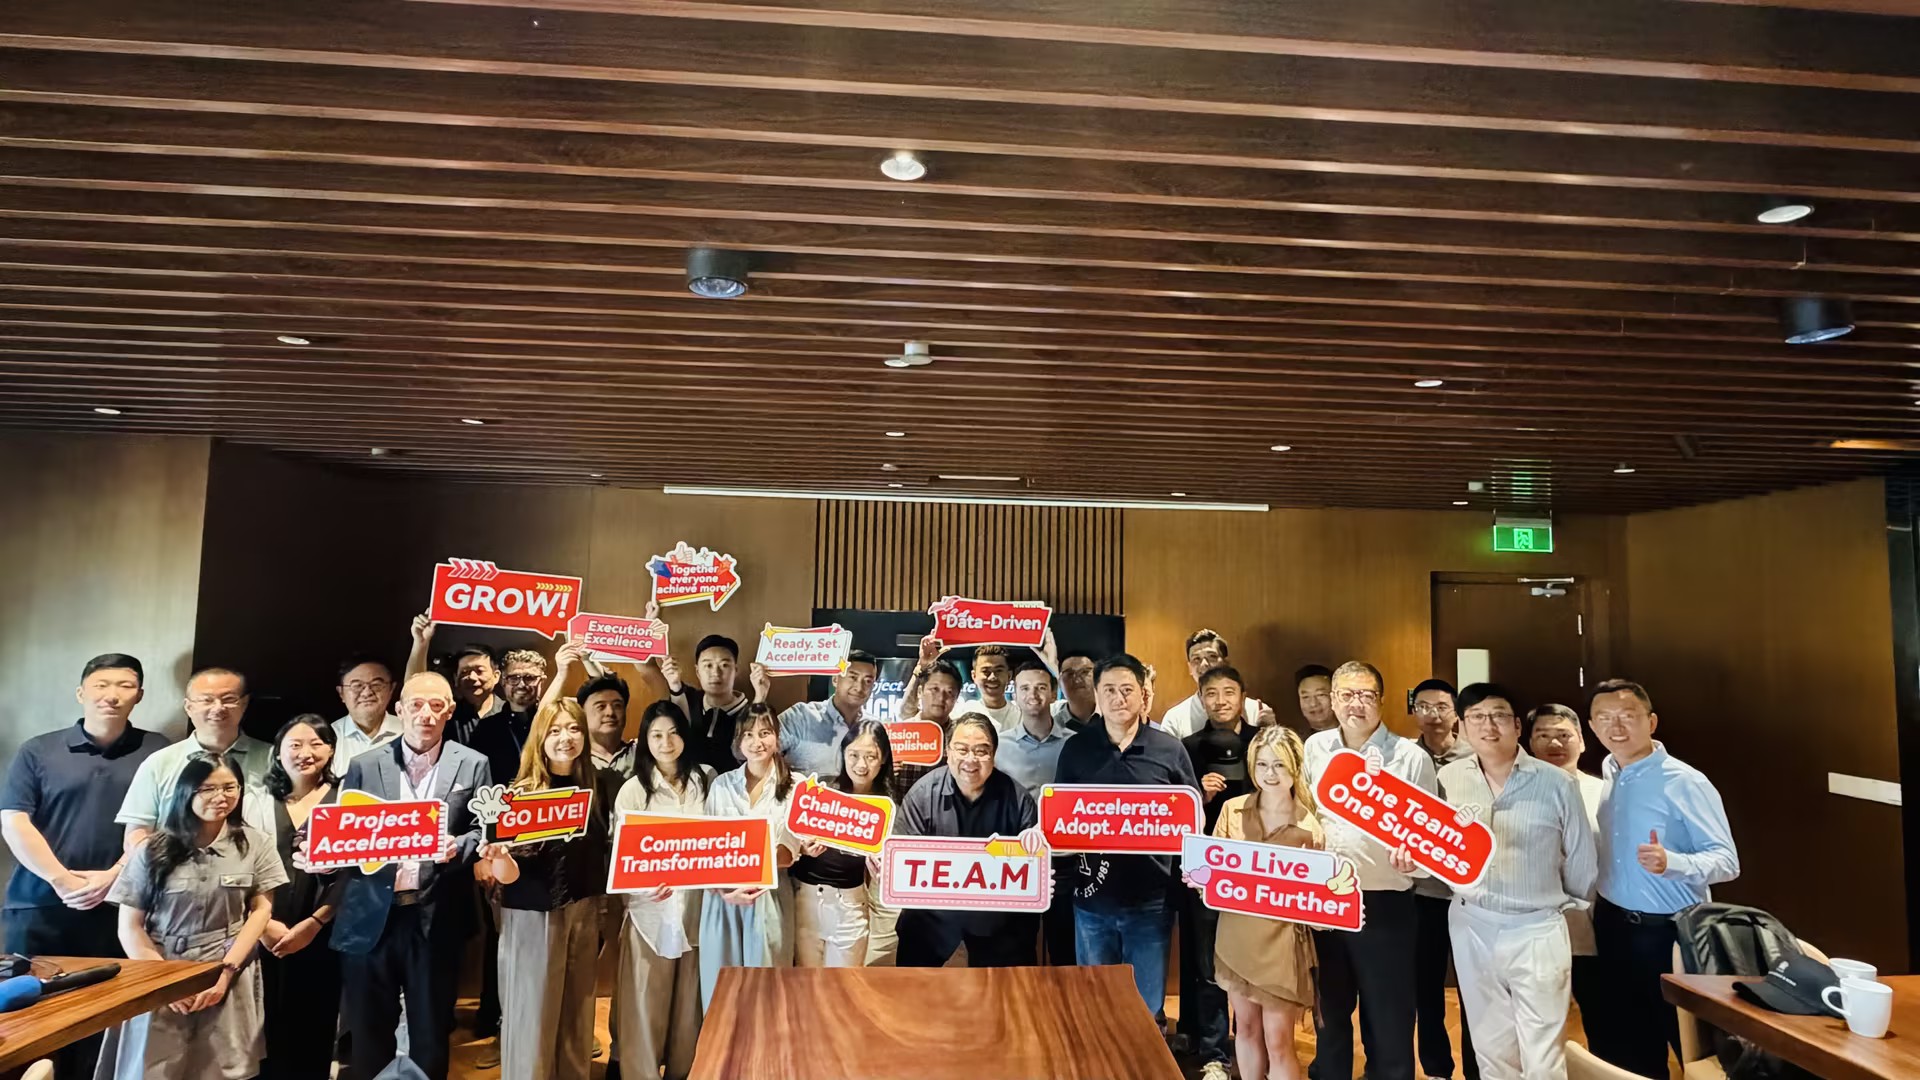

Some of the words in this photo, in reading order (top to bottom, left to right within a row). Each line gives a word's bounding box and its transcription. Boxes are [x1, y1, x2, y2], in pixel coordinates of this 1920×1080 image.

[669, 575, 719, 586] everyone
[670, 563, 719, 576] Together
[656, 583, 698, 594] achieve
[700, 582, 731, 593] more!
[444, 583, 571, 618] GROW!
[588, 620, 653, 637] Execution
[945, 613, 1042, 630] Data-Driven
[584, 632, 653, 649] Excellence
[773, 638, 814, 651] Ready.
[765, 650, 830, 662] Accelerate
[888, 728, 920, 740] ission
[502, 810, 531, 828] GO
[536, 802, 584, 823] LIVE!
[798, 794, 880, 825] Challenge
[1071, 797, 1173, 817] Accelerate.
[1351, 771, 1399, 809] One
[1402, 798, 1467, 851] Team.
[338, 809, 421, 836] Project
[796, 810, 875, 841] Accepted
[1052, 816, 1115, 840] Adopt.
[1119, 818, 1192, 837] Achieve
[1328, 783, 1375, 820] One
[1377, 811, 1471, 876] Success
[313, 831, 434, 855] Accelerate
[639, 831, 746, 853] Commercial
[621, 851, 760, 874] Transformation
[1096, 859, 1110, 885] 1985
[1204, 844, 1242, 869] Go
[1251, 850, 1310, 879] Live
[903, 858, 1030, 891] T.E.A.M
[1215, 878, 1248, 901] Go
[1255, 884, 1351, 917] Further
